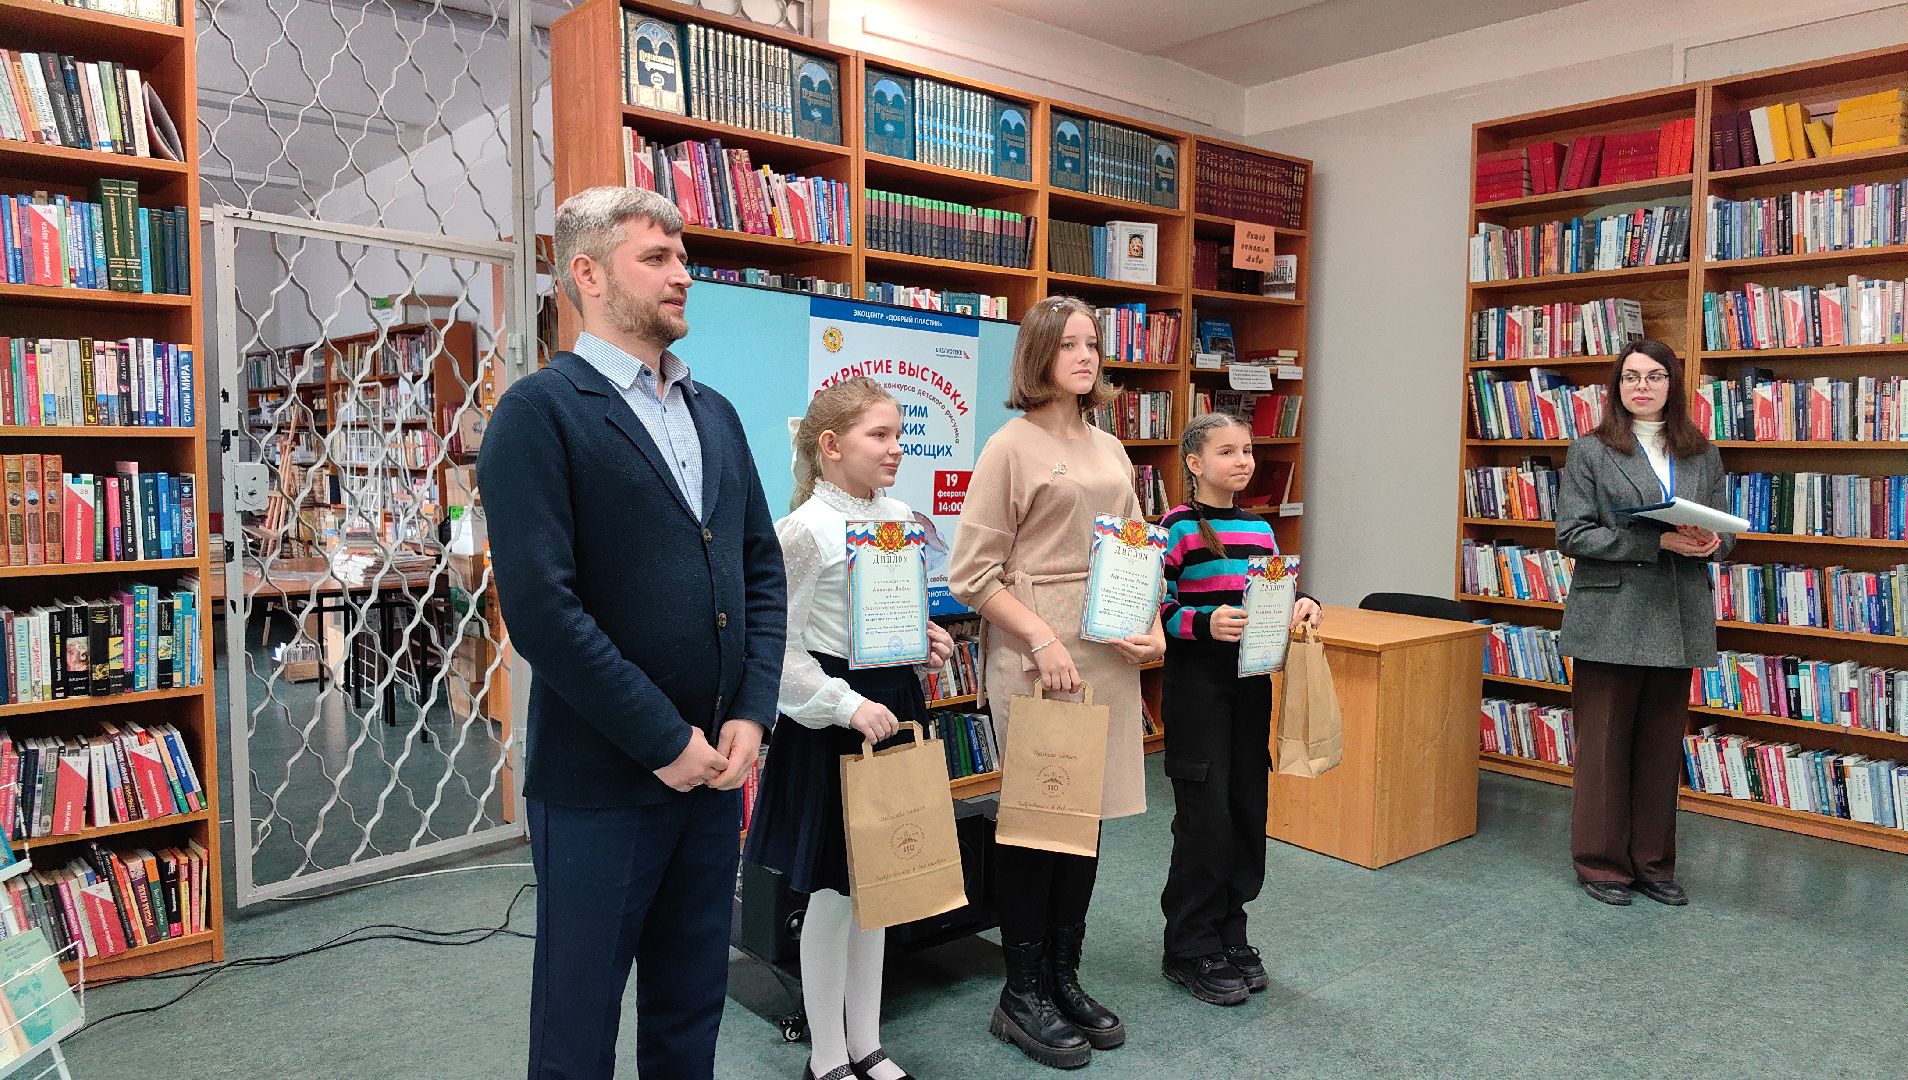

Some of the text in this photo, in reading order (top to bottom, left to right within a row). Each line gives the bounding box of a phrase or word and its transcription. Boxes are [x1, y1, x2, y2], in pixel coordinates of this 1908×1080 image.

[182, 363, 193, 423] СТРАНЫ МИРА
[898, 360, 970, 417] ВЫСТАВКИ
[901, 404, 929, 419] ТИМ
[901, 422, 926, 436] КИХ
[945, 473, 959, 487] 19
[938, 501, 962, 513] 14:00
